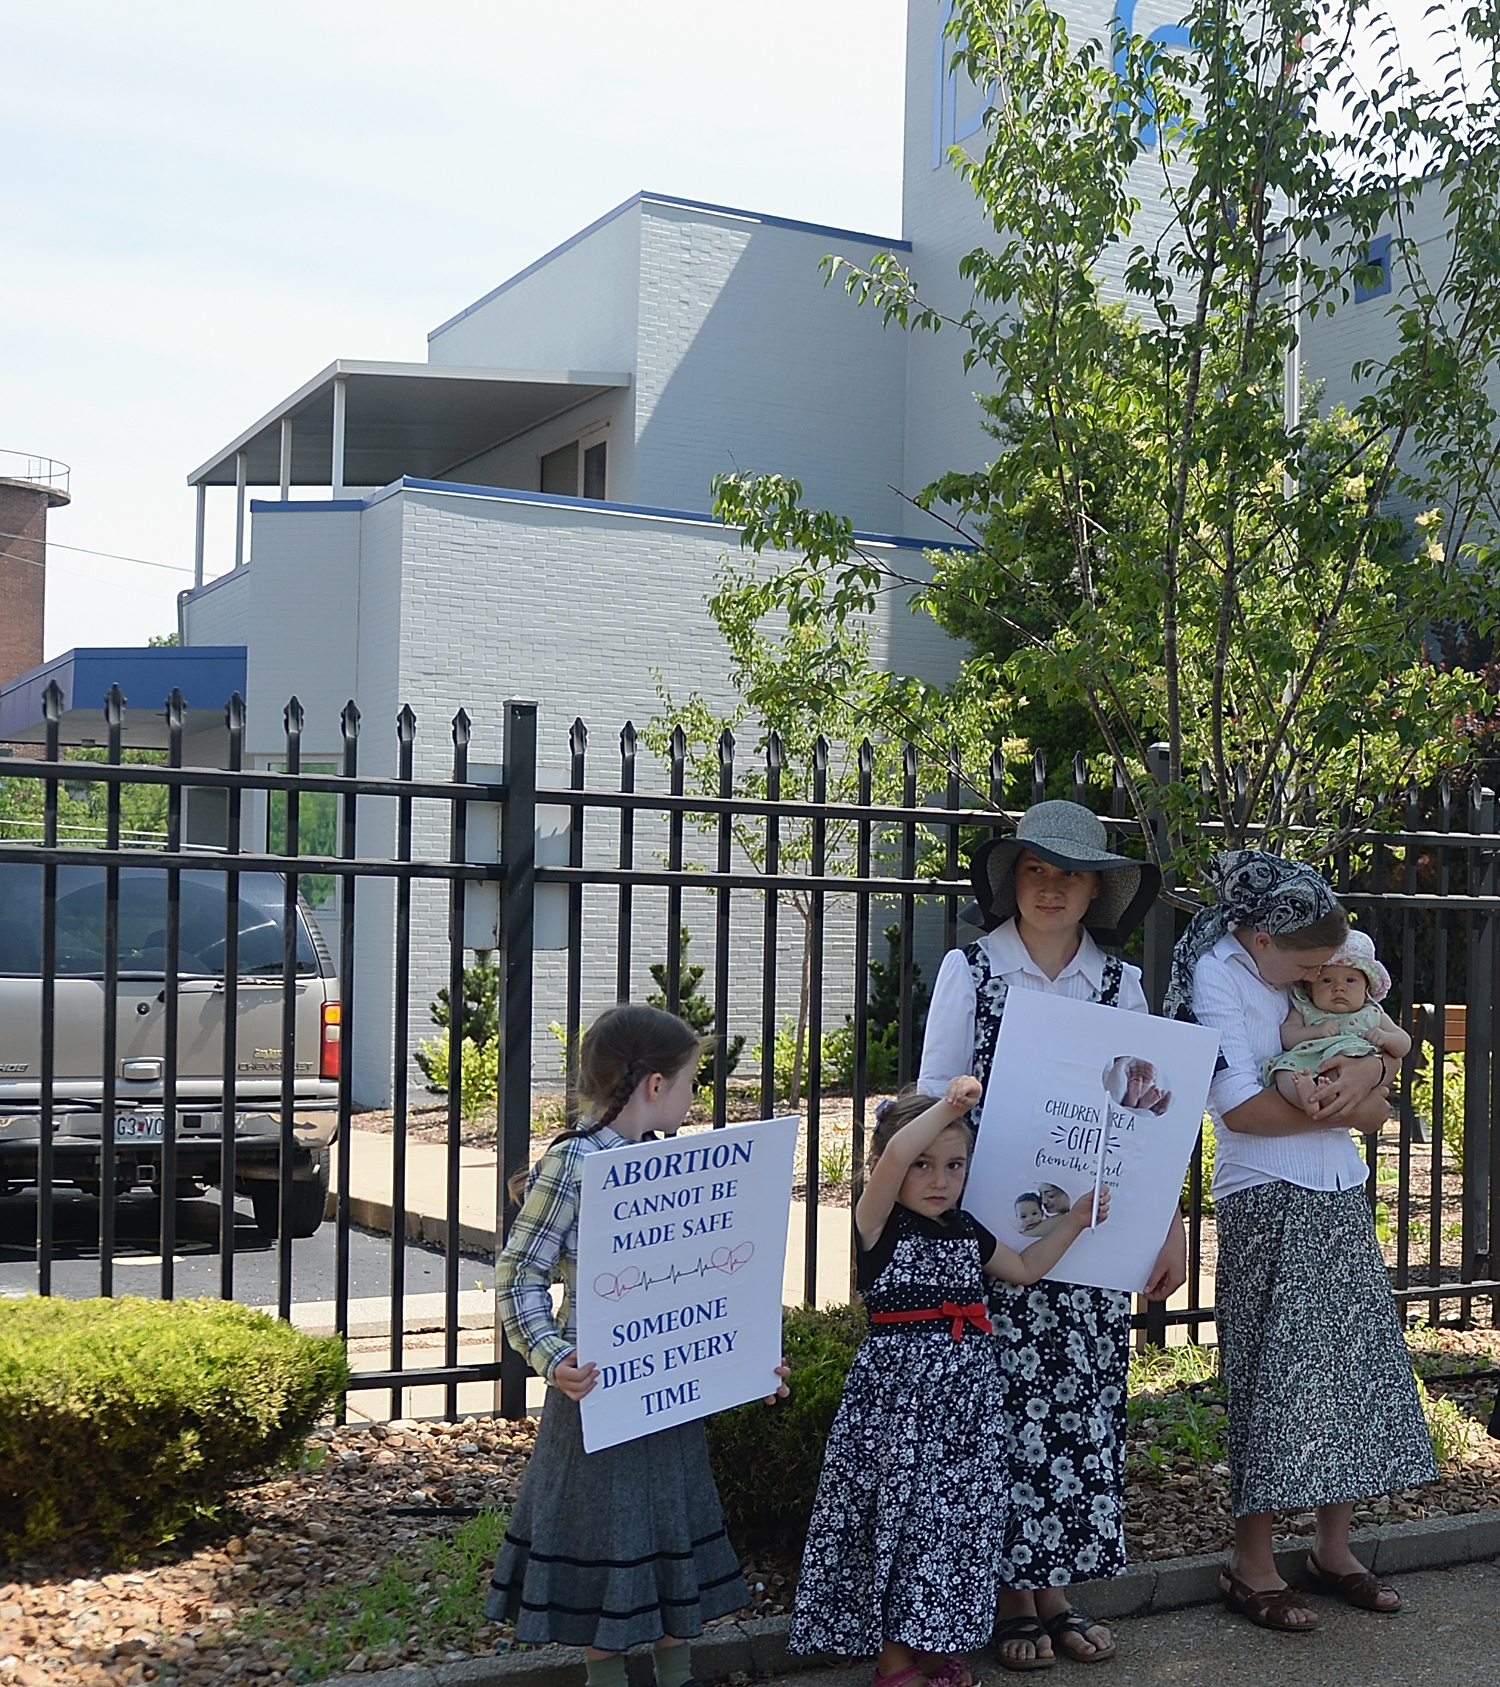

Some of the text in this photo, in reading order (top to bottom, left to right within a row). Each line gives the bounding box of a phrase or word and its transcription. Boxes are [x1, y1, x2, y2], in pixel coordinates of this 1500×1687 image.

[238, 1062, 313, 1071] CHEVRLET
[1045, 1099, 1101, 1123] CHILDREN
[1126, 1116, 1135, 1131] A
[1067, 1126, 1102, 1154] GIFT
[602, 1140, 754, 1190] ABORTION
[1035, 1148, 1069, 1167] from
[1068, 1156, 1090, 1172] the
[614, 1179, 738, 1221] CANNOT BE
[612, 1211, 733, 1253] MADE SAFE
[612, 1297, 728, 1348] SOMEONE
[602, 1330, 738, 1390] DIES EVERY
[641, 1379, 701, 1416] TIME
